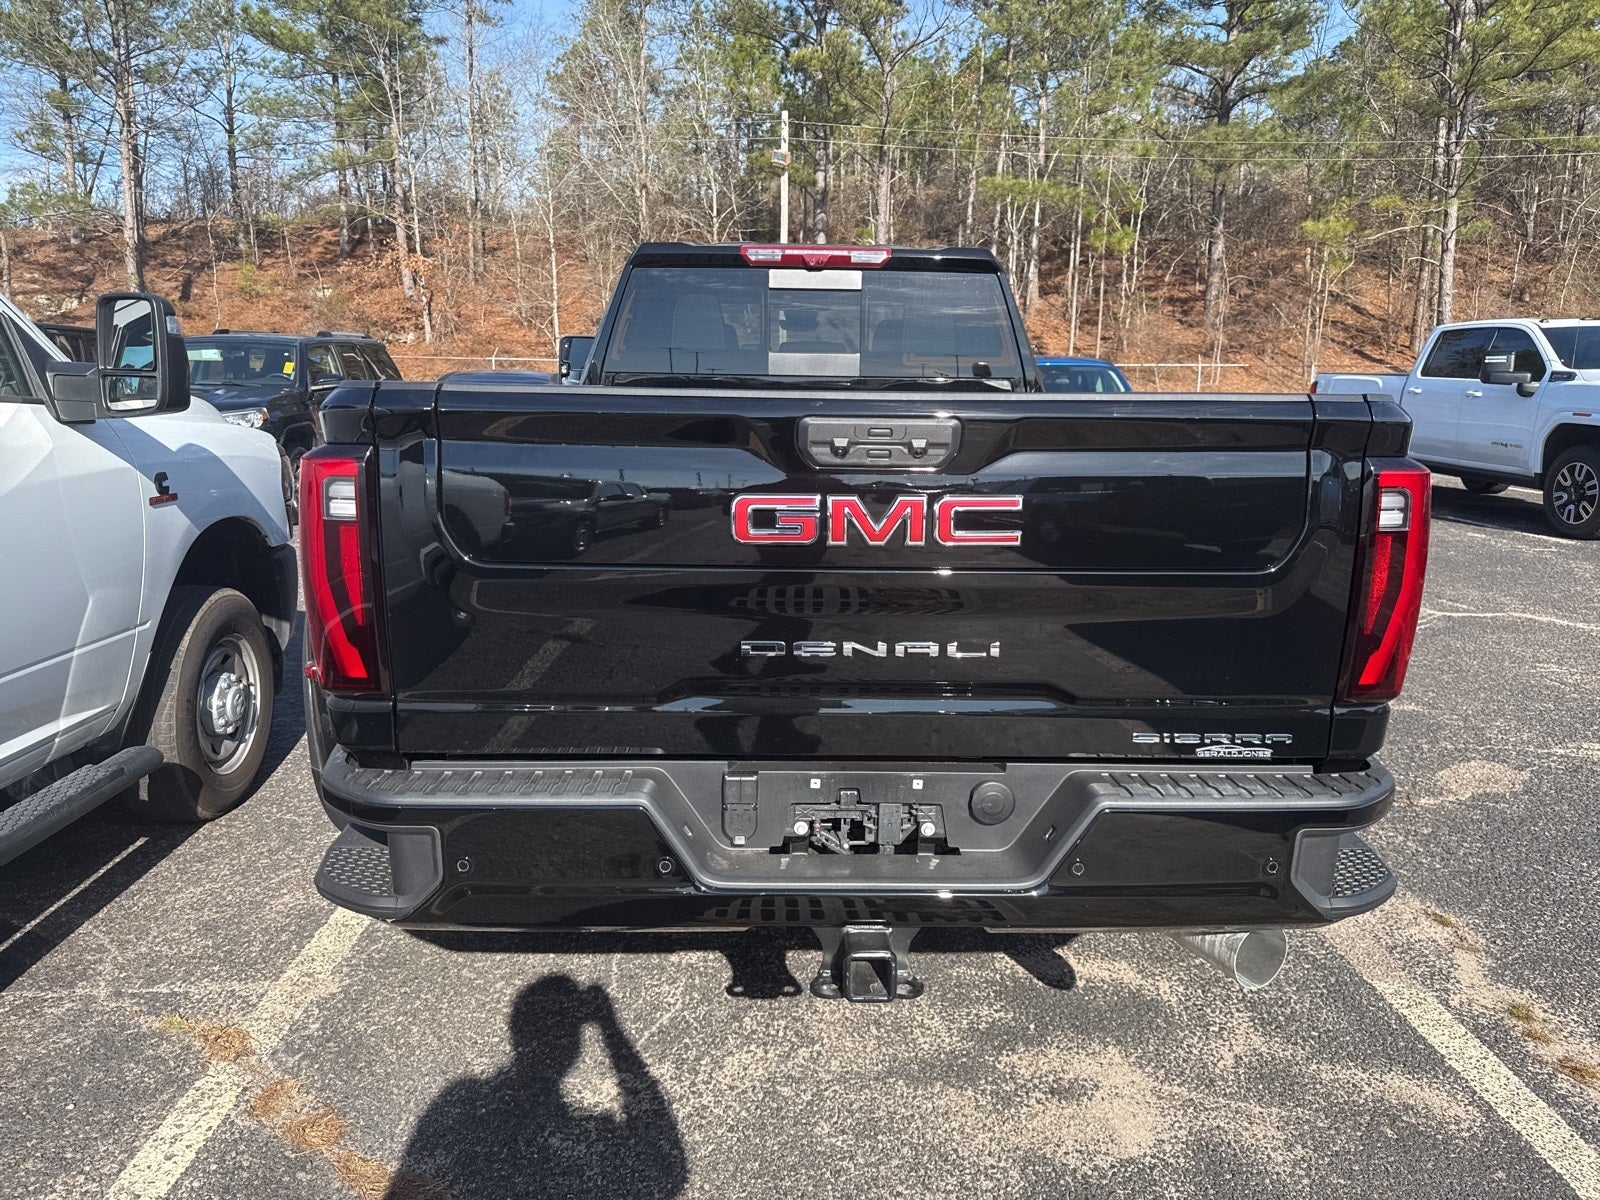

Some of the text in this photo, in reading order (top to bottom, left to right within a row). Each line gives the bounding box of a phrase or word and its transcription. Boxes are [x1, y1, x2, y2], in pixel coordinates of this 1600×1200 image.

[731, 493, 1024, 547] GMC
[740, 640, 1000, 658] DENALI
[1132, 732, 1293, 744] SIERRA
